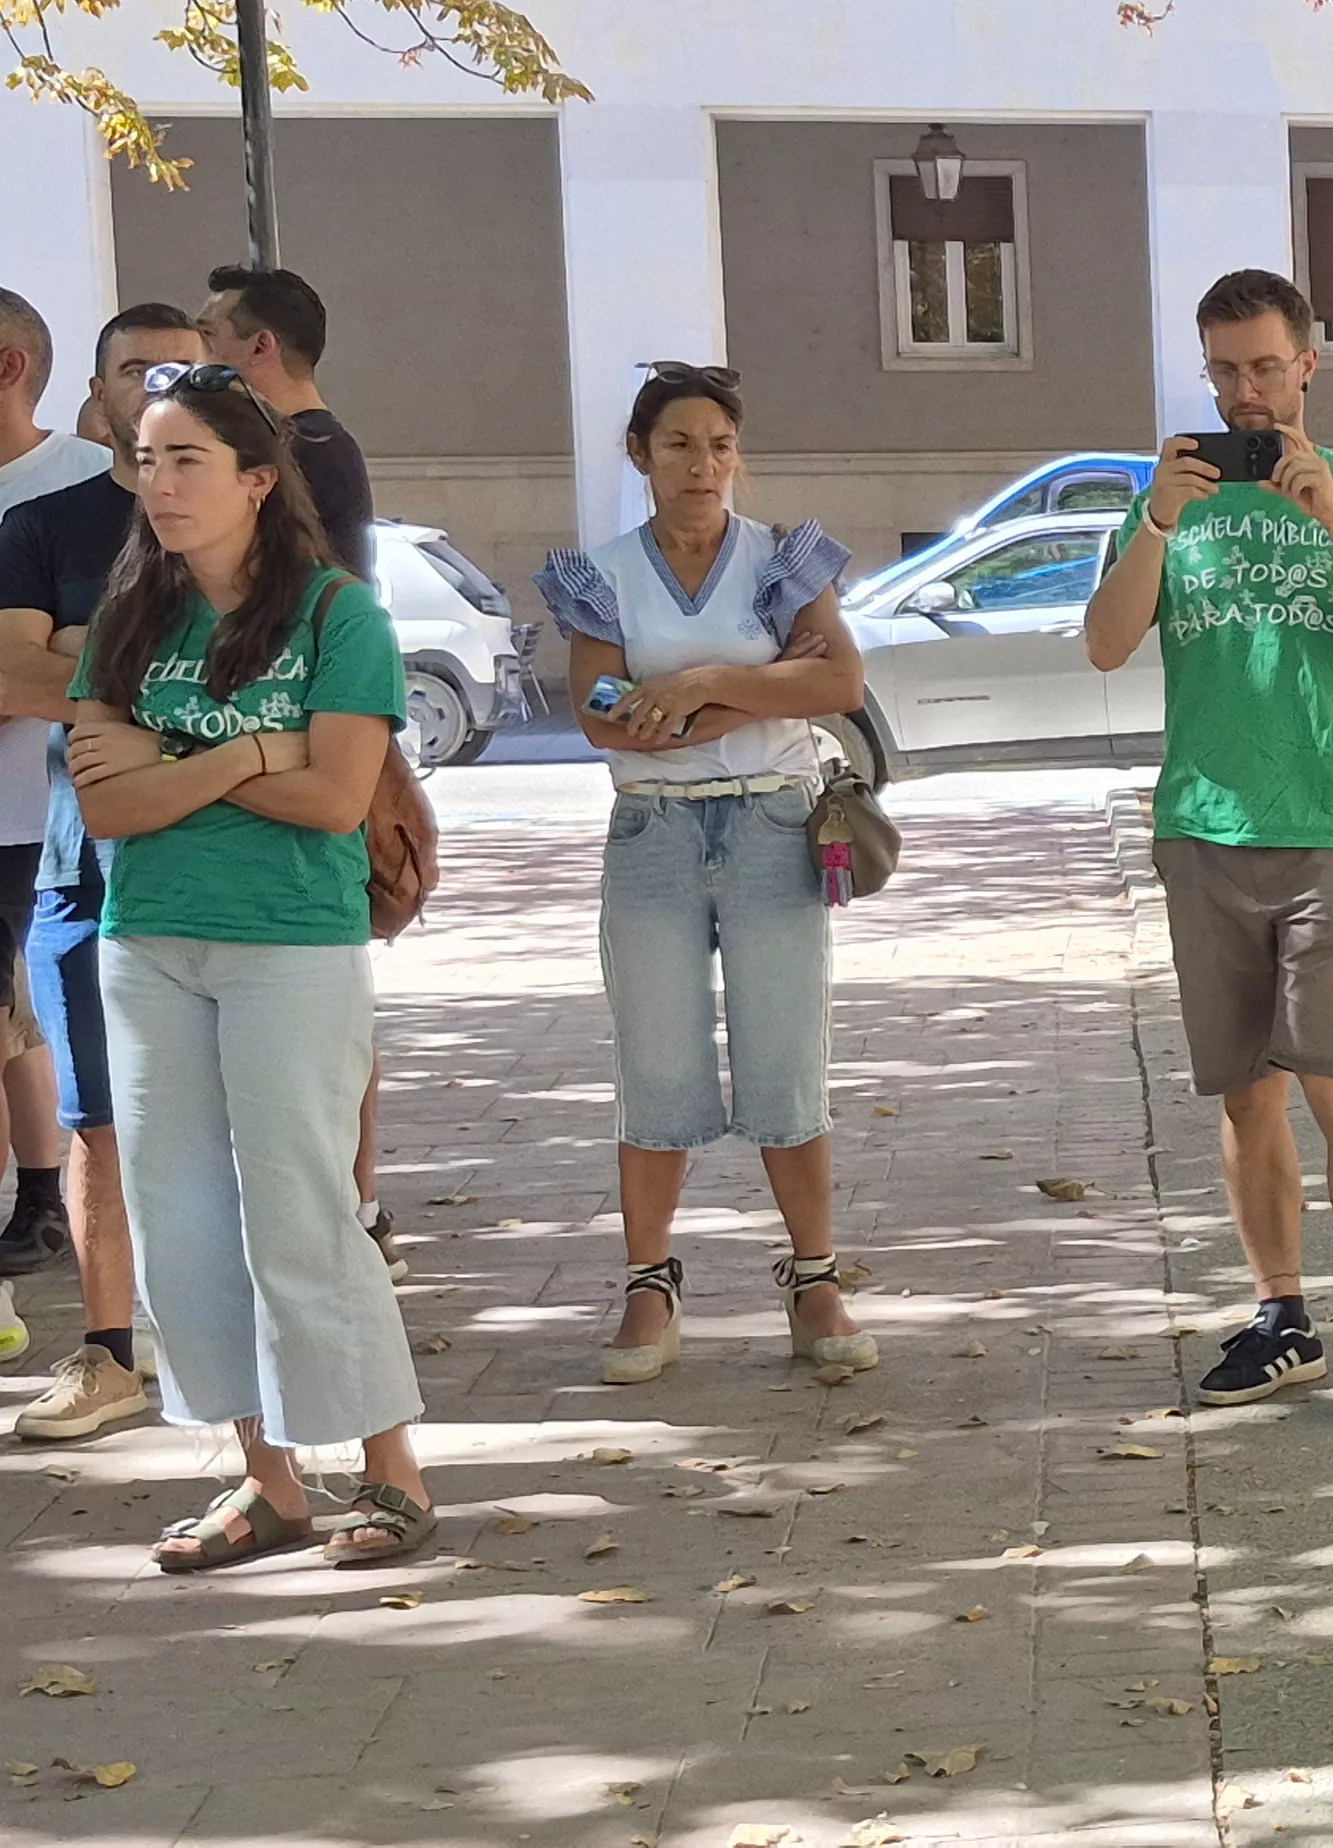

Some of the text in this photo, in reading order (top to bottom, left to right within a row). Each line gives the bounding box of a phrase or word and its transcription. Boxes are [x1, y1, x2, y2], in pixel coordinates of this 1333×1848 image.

[1167, 513, 1333, 555] ESCUELA PÚBLIC
[1182, 563, 1327, 594] DE TOD@S
[1174, 602, 1244, 640] PARA
[179, 703, 284, 738] TOD@S
